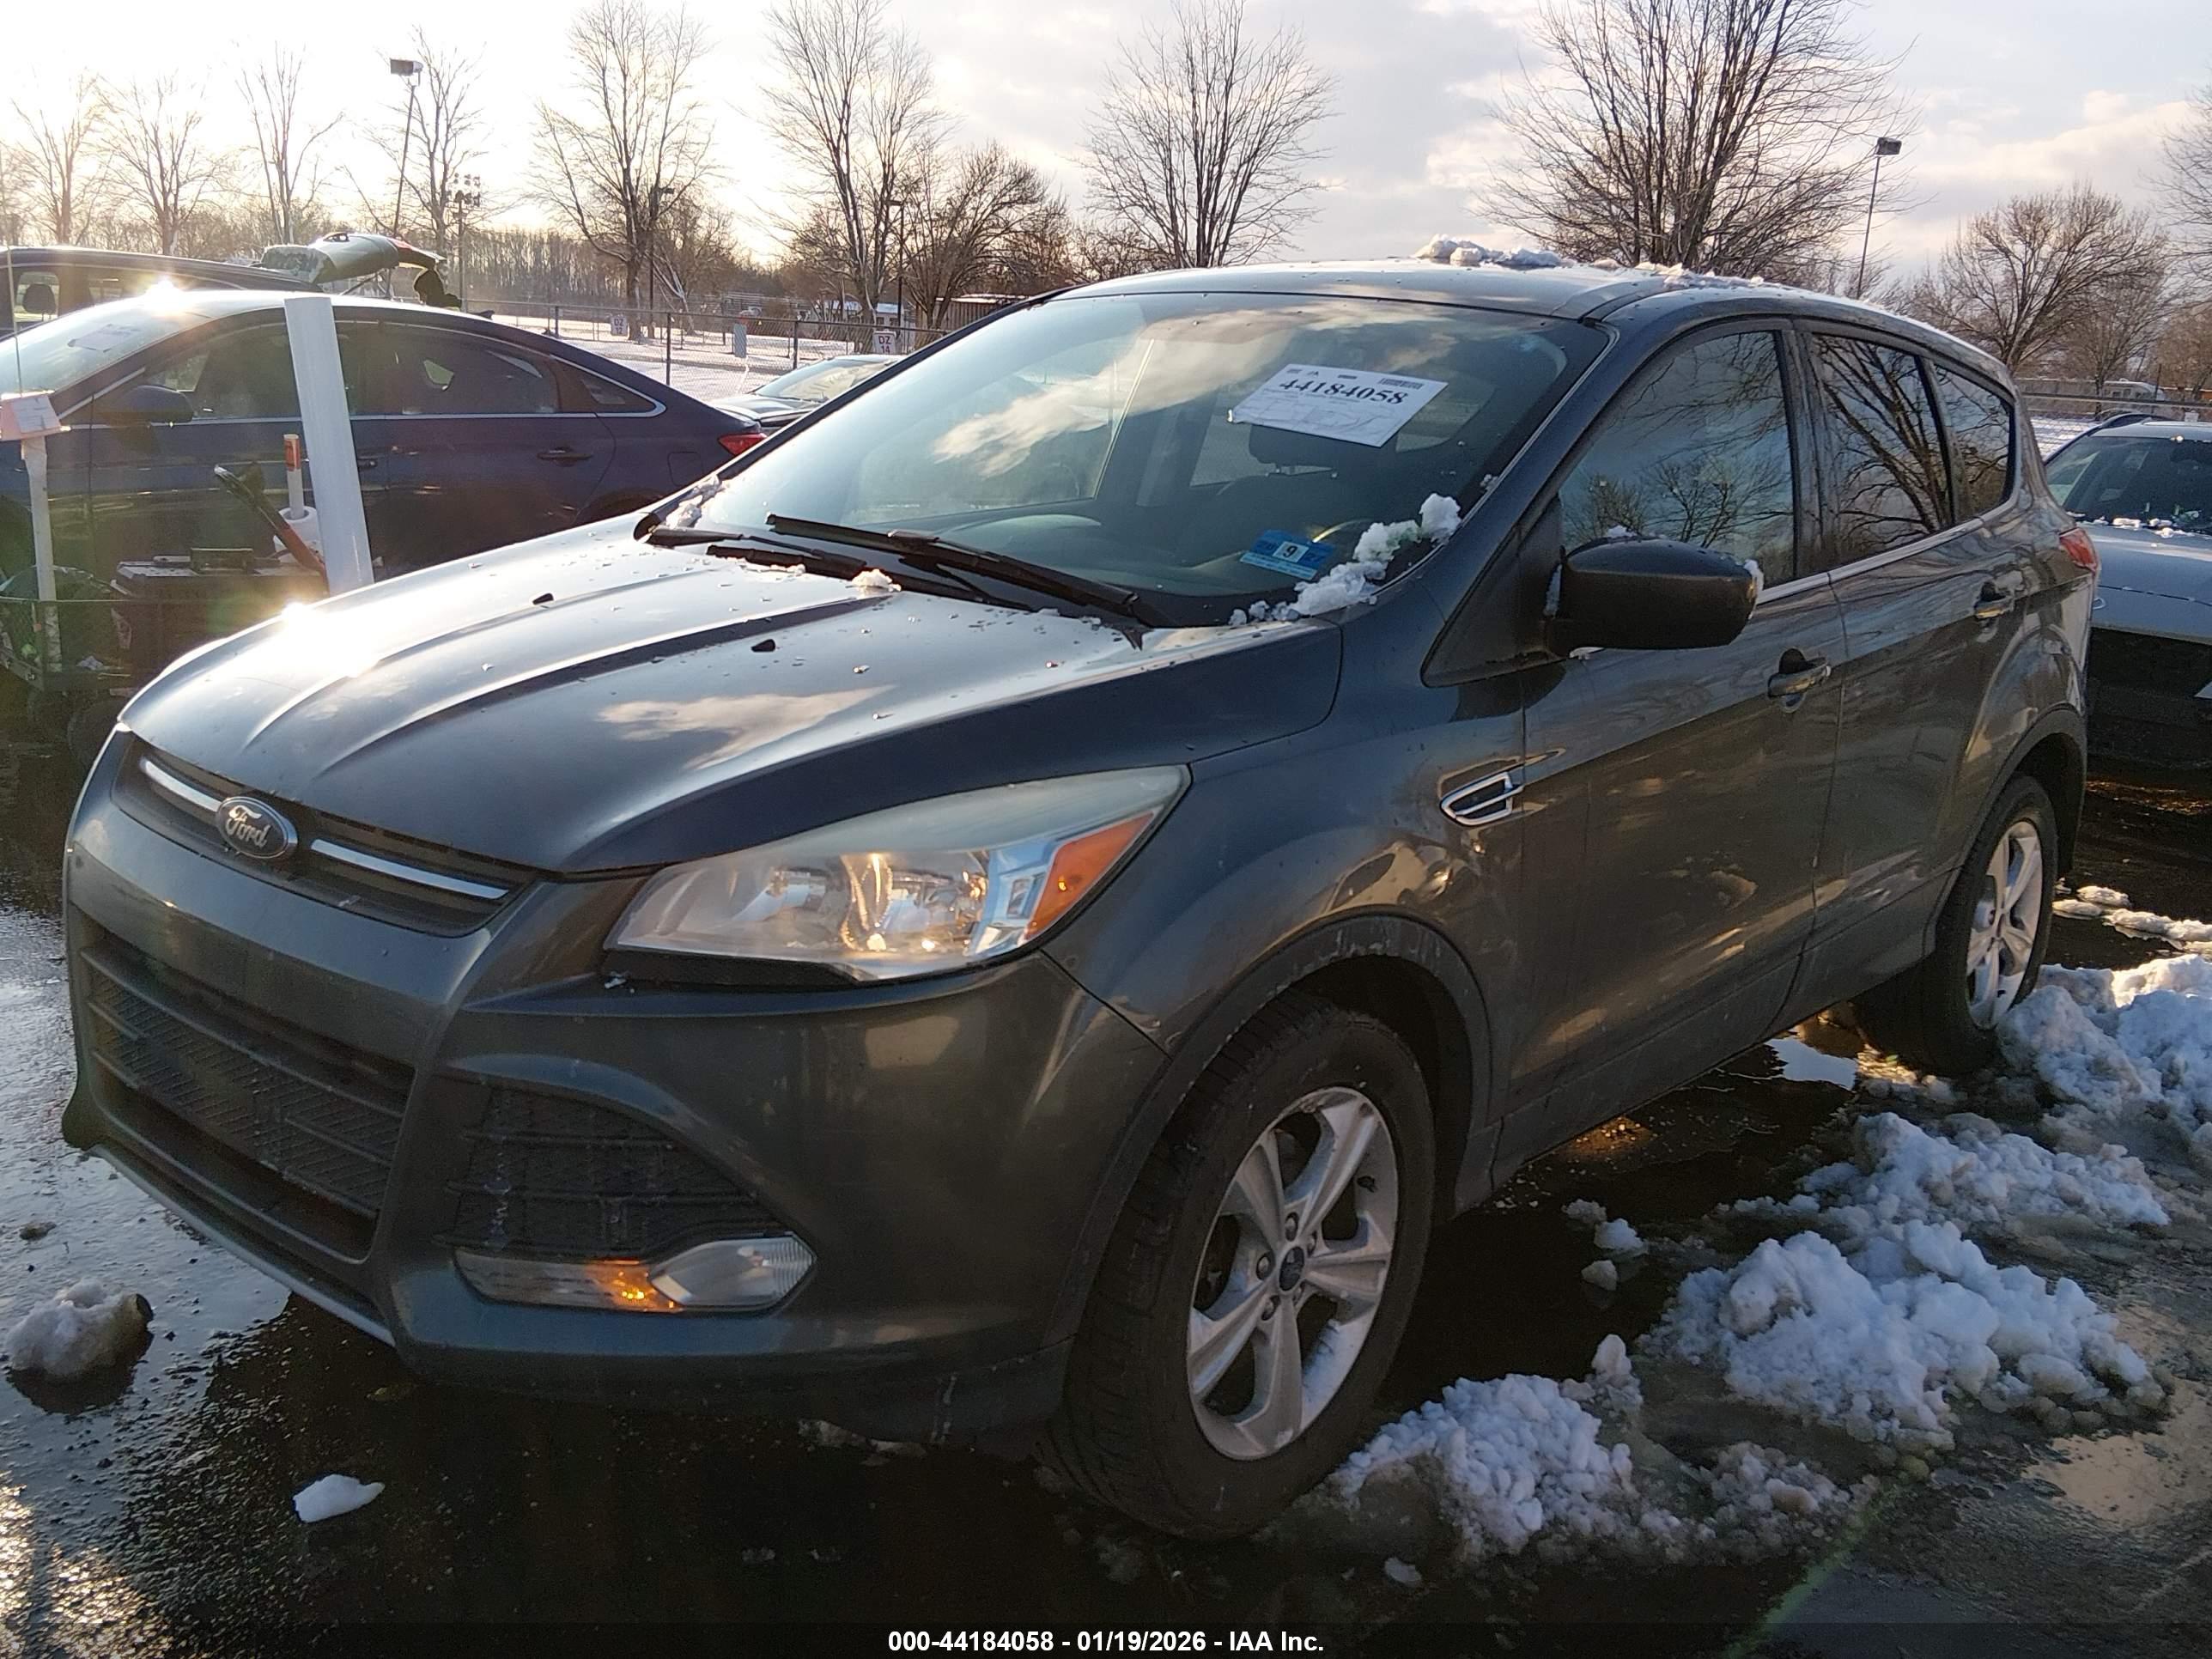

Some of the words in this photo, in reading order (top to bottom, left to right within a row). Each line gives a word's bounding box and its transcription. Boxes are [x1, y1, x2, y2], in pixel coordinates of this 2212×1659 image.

[878, 336, 891, 344] DZ
[1279, 379, 1408, 404] 44184058
[1283, 545, 1298, 557] 9
[226, 805, 271, 848] Ford
